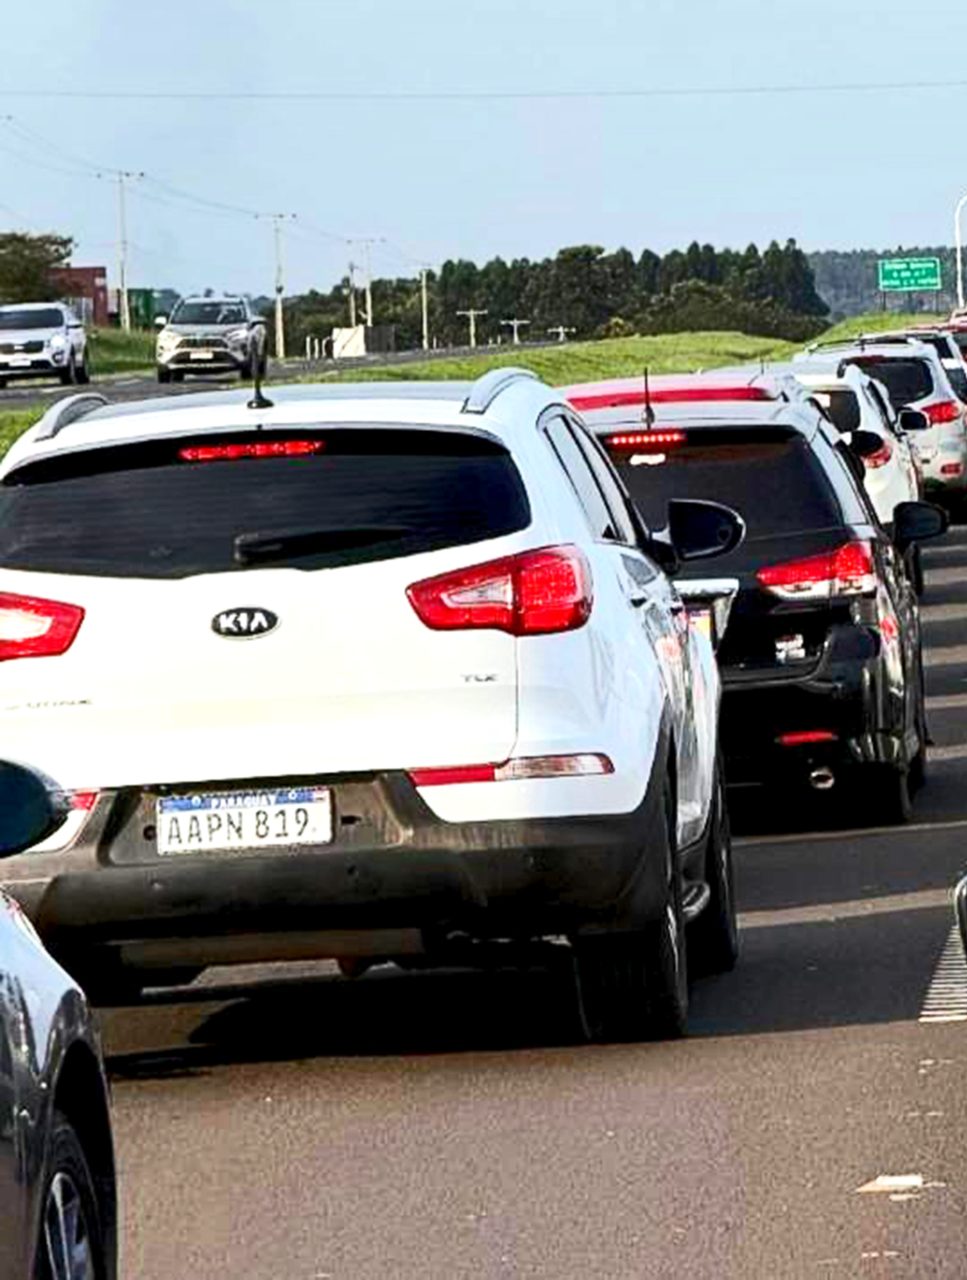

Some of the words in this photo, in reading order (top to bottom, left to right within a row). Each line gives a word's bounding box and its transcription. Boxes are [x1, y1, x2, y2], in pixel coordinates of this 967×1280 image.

[220, 612, 268, 632] KIA
[168, 811, 243, 845] AAPN
[255, 808, 310, 839] 819
